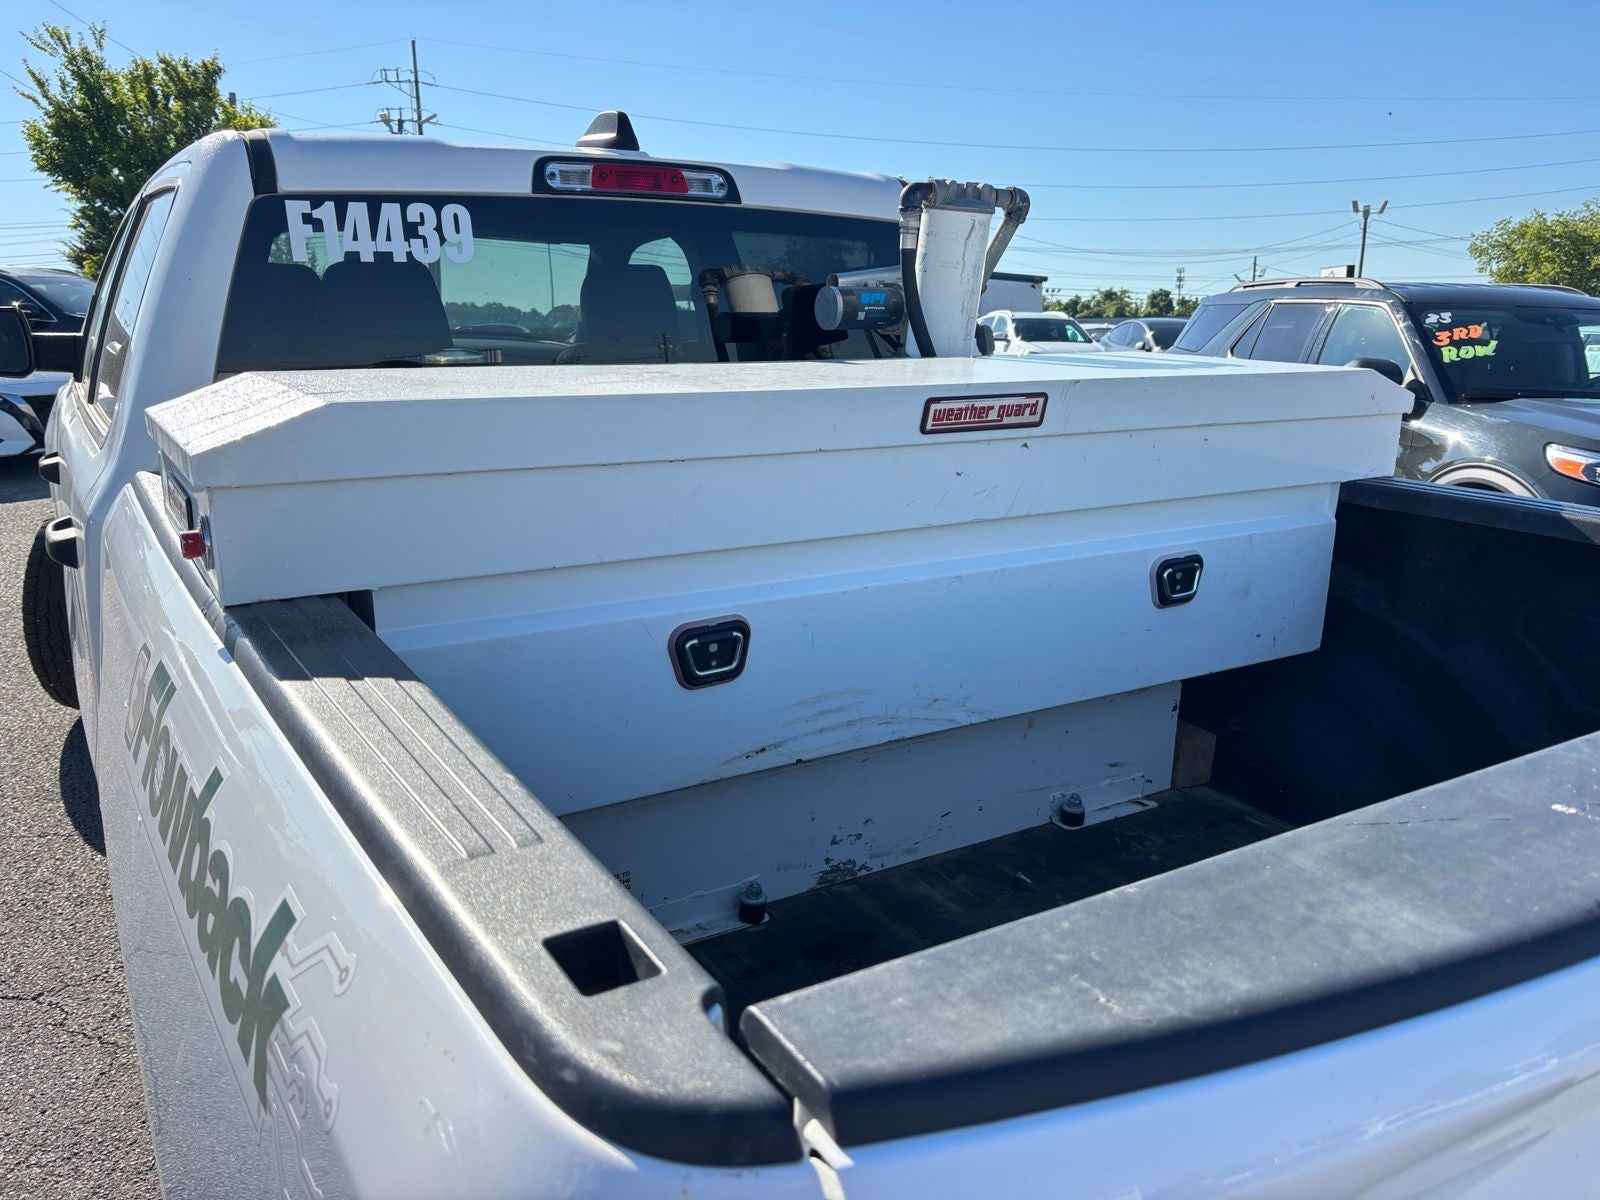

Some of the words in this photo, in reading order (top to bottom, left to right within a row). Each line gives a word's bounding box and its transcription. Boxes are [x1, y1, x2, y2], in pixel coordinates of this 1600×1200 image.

[284, 199, 475, 264] F14439
[1432, 324, 1482, 346] 3RD
[932, 404, 994, 422] weather
[997, 400, 1039, 422] guard
[132, 659, 298, 1113] Flowback
